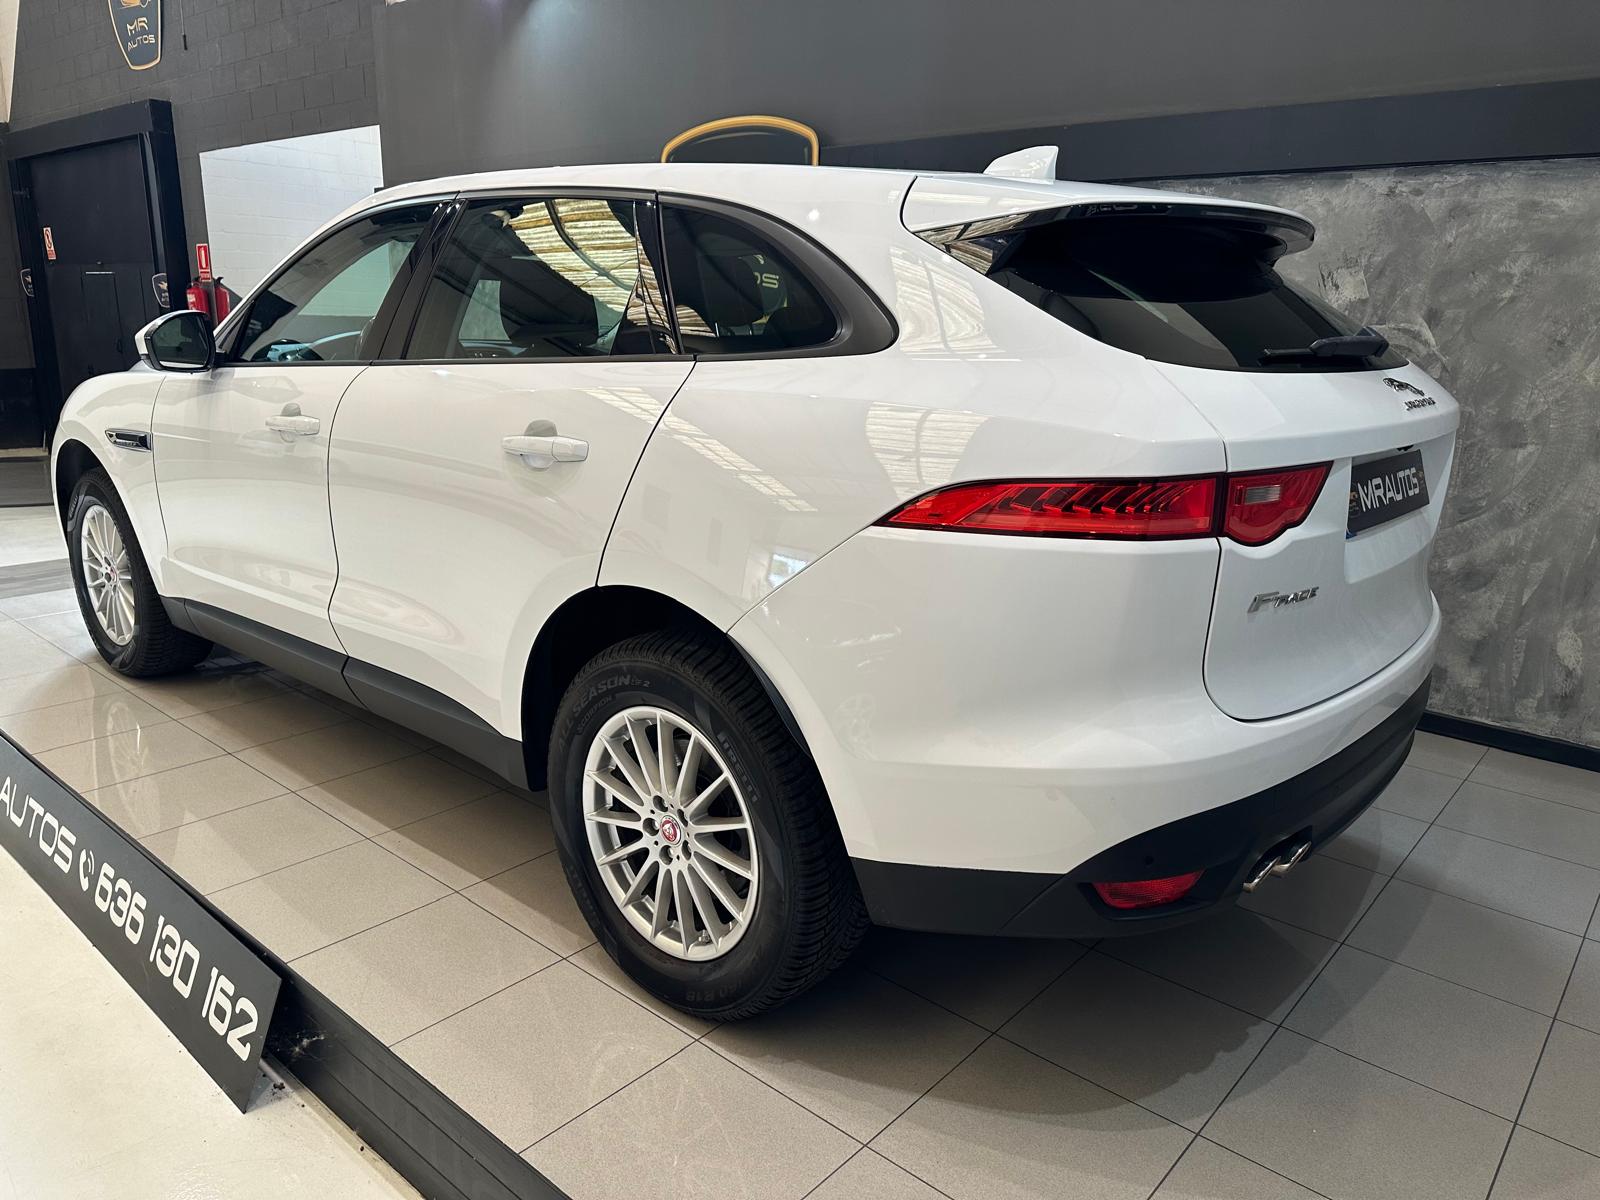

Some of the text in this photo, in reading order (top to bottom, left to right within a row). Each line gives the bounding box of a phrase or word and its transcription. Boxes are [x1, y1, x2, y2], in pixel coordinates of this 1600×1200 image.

[126, 17, 149, 37] MR
[127, 34, 156, 52] AUTOS
[572, 674, 631, 717] SEASON
[0, 776, 260, 1061] AUTOS 636 130 162
